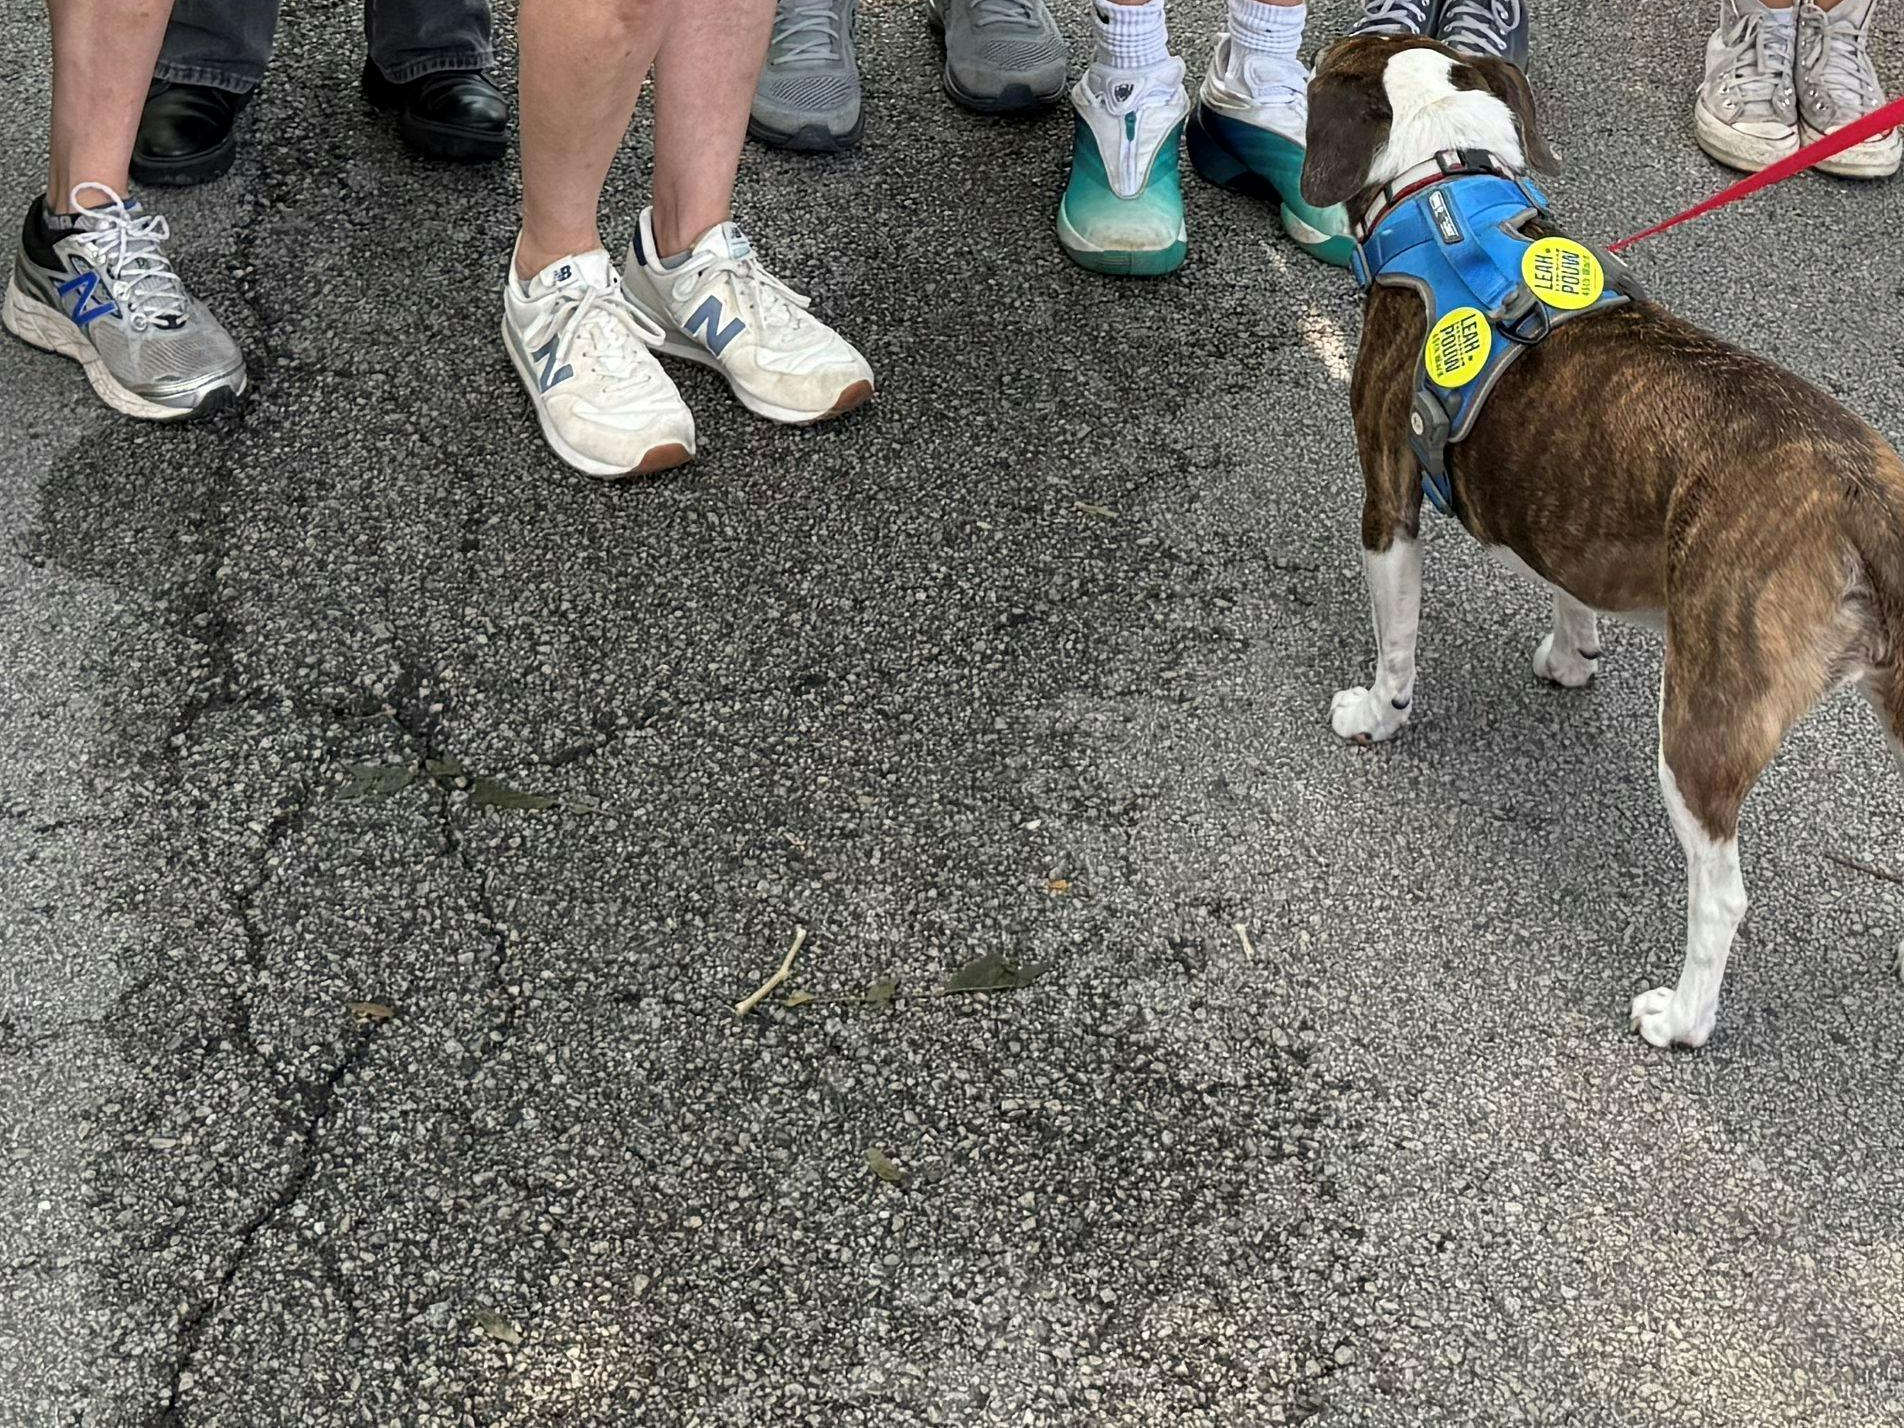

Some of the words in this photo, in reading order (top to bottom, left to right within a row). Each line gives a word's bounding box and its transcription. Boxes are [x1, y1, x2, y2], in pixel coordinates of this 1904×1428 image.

[1535, 254, 1554, 291] LEAH
[1561, 250, 1580, 295] POUW
[1439, 323, 1461, 373] POUW
[1460, 313, 1481, 354] LEAH
